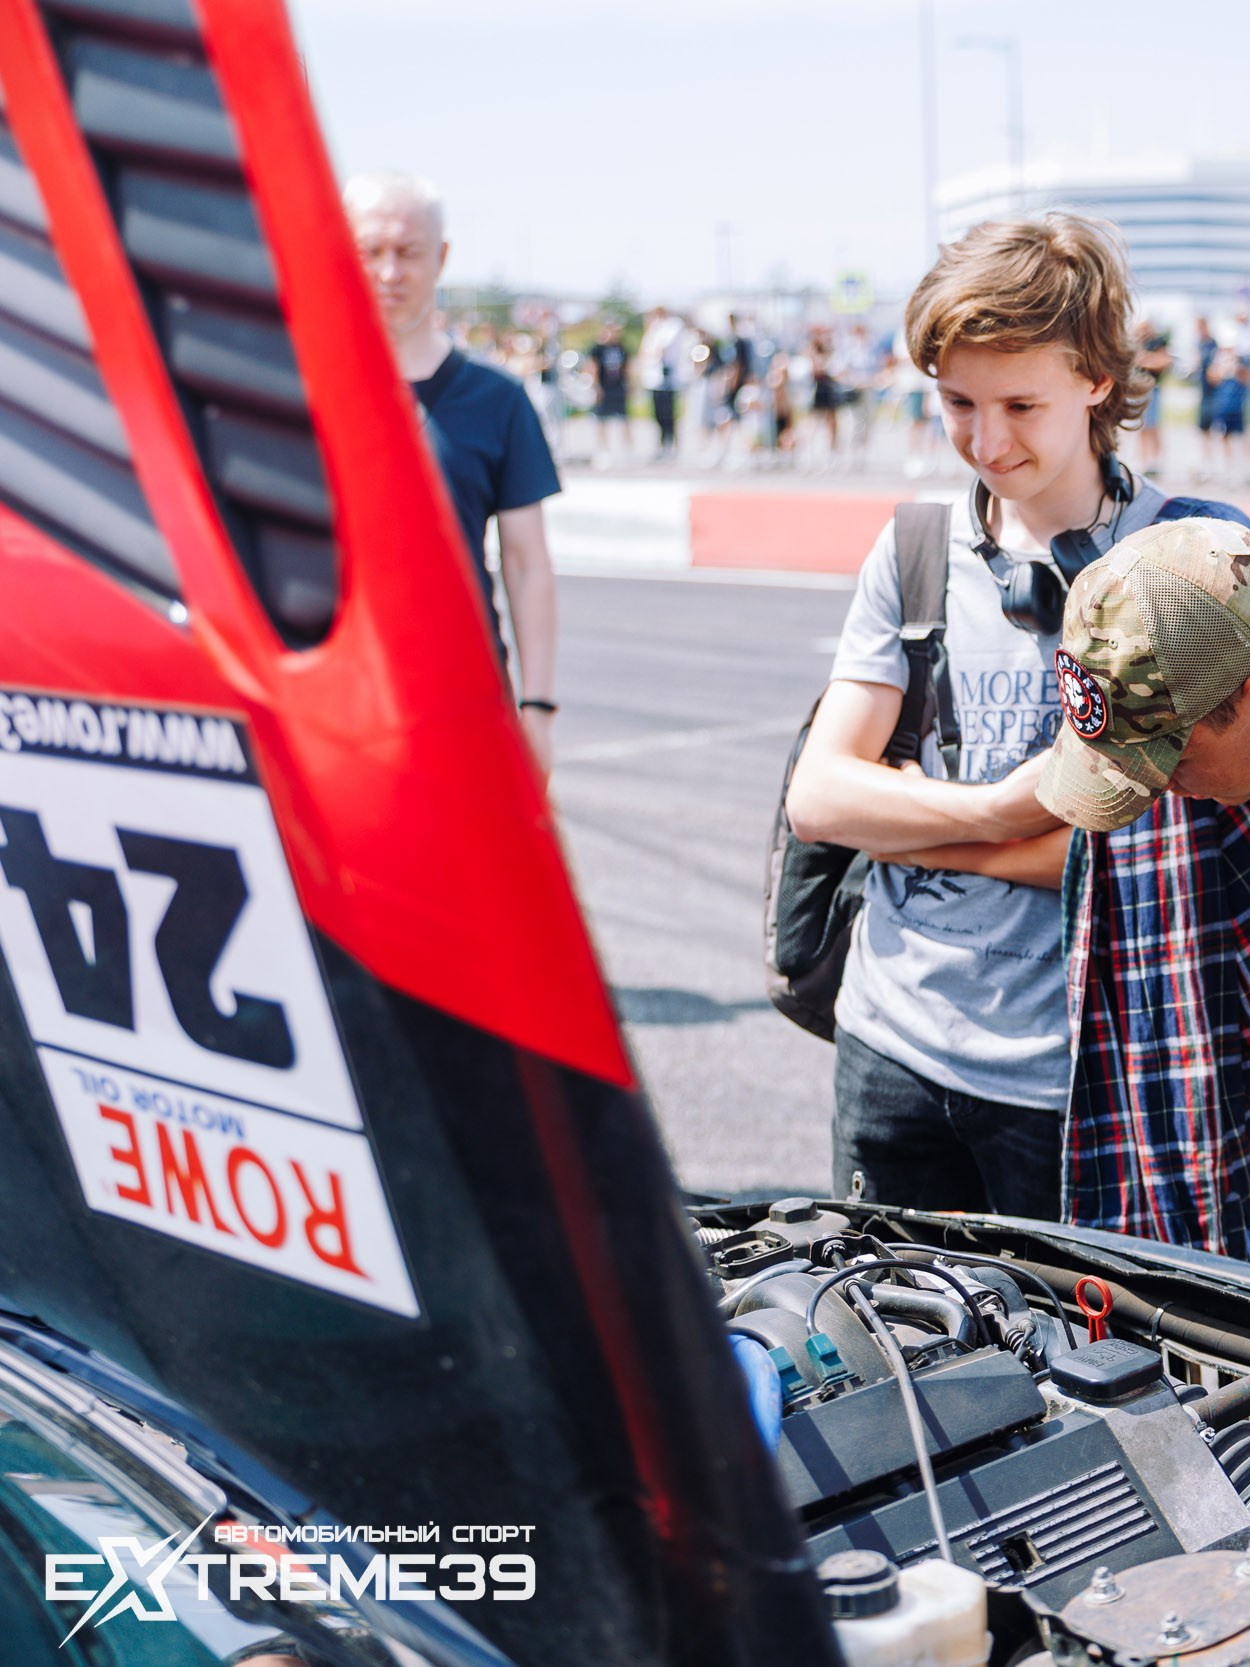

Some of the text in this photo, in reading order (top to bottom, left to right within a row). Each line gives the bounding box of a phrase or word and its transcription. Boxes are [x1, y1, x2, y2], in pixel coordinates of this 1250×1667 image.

[959, 670, 1061, 706] MORE
[956, 708, 1063, 745] ESPEC
[0, 807, 297, 1072] 24
[73, 1067, 246, 1139] MOTOR OIL
[98, 1103, 372, 1282] ROWE
